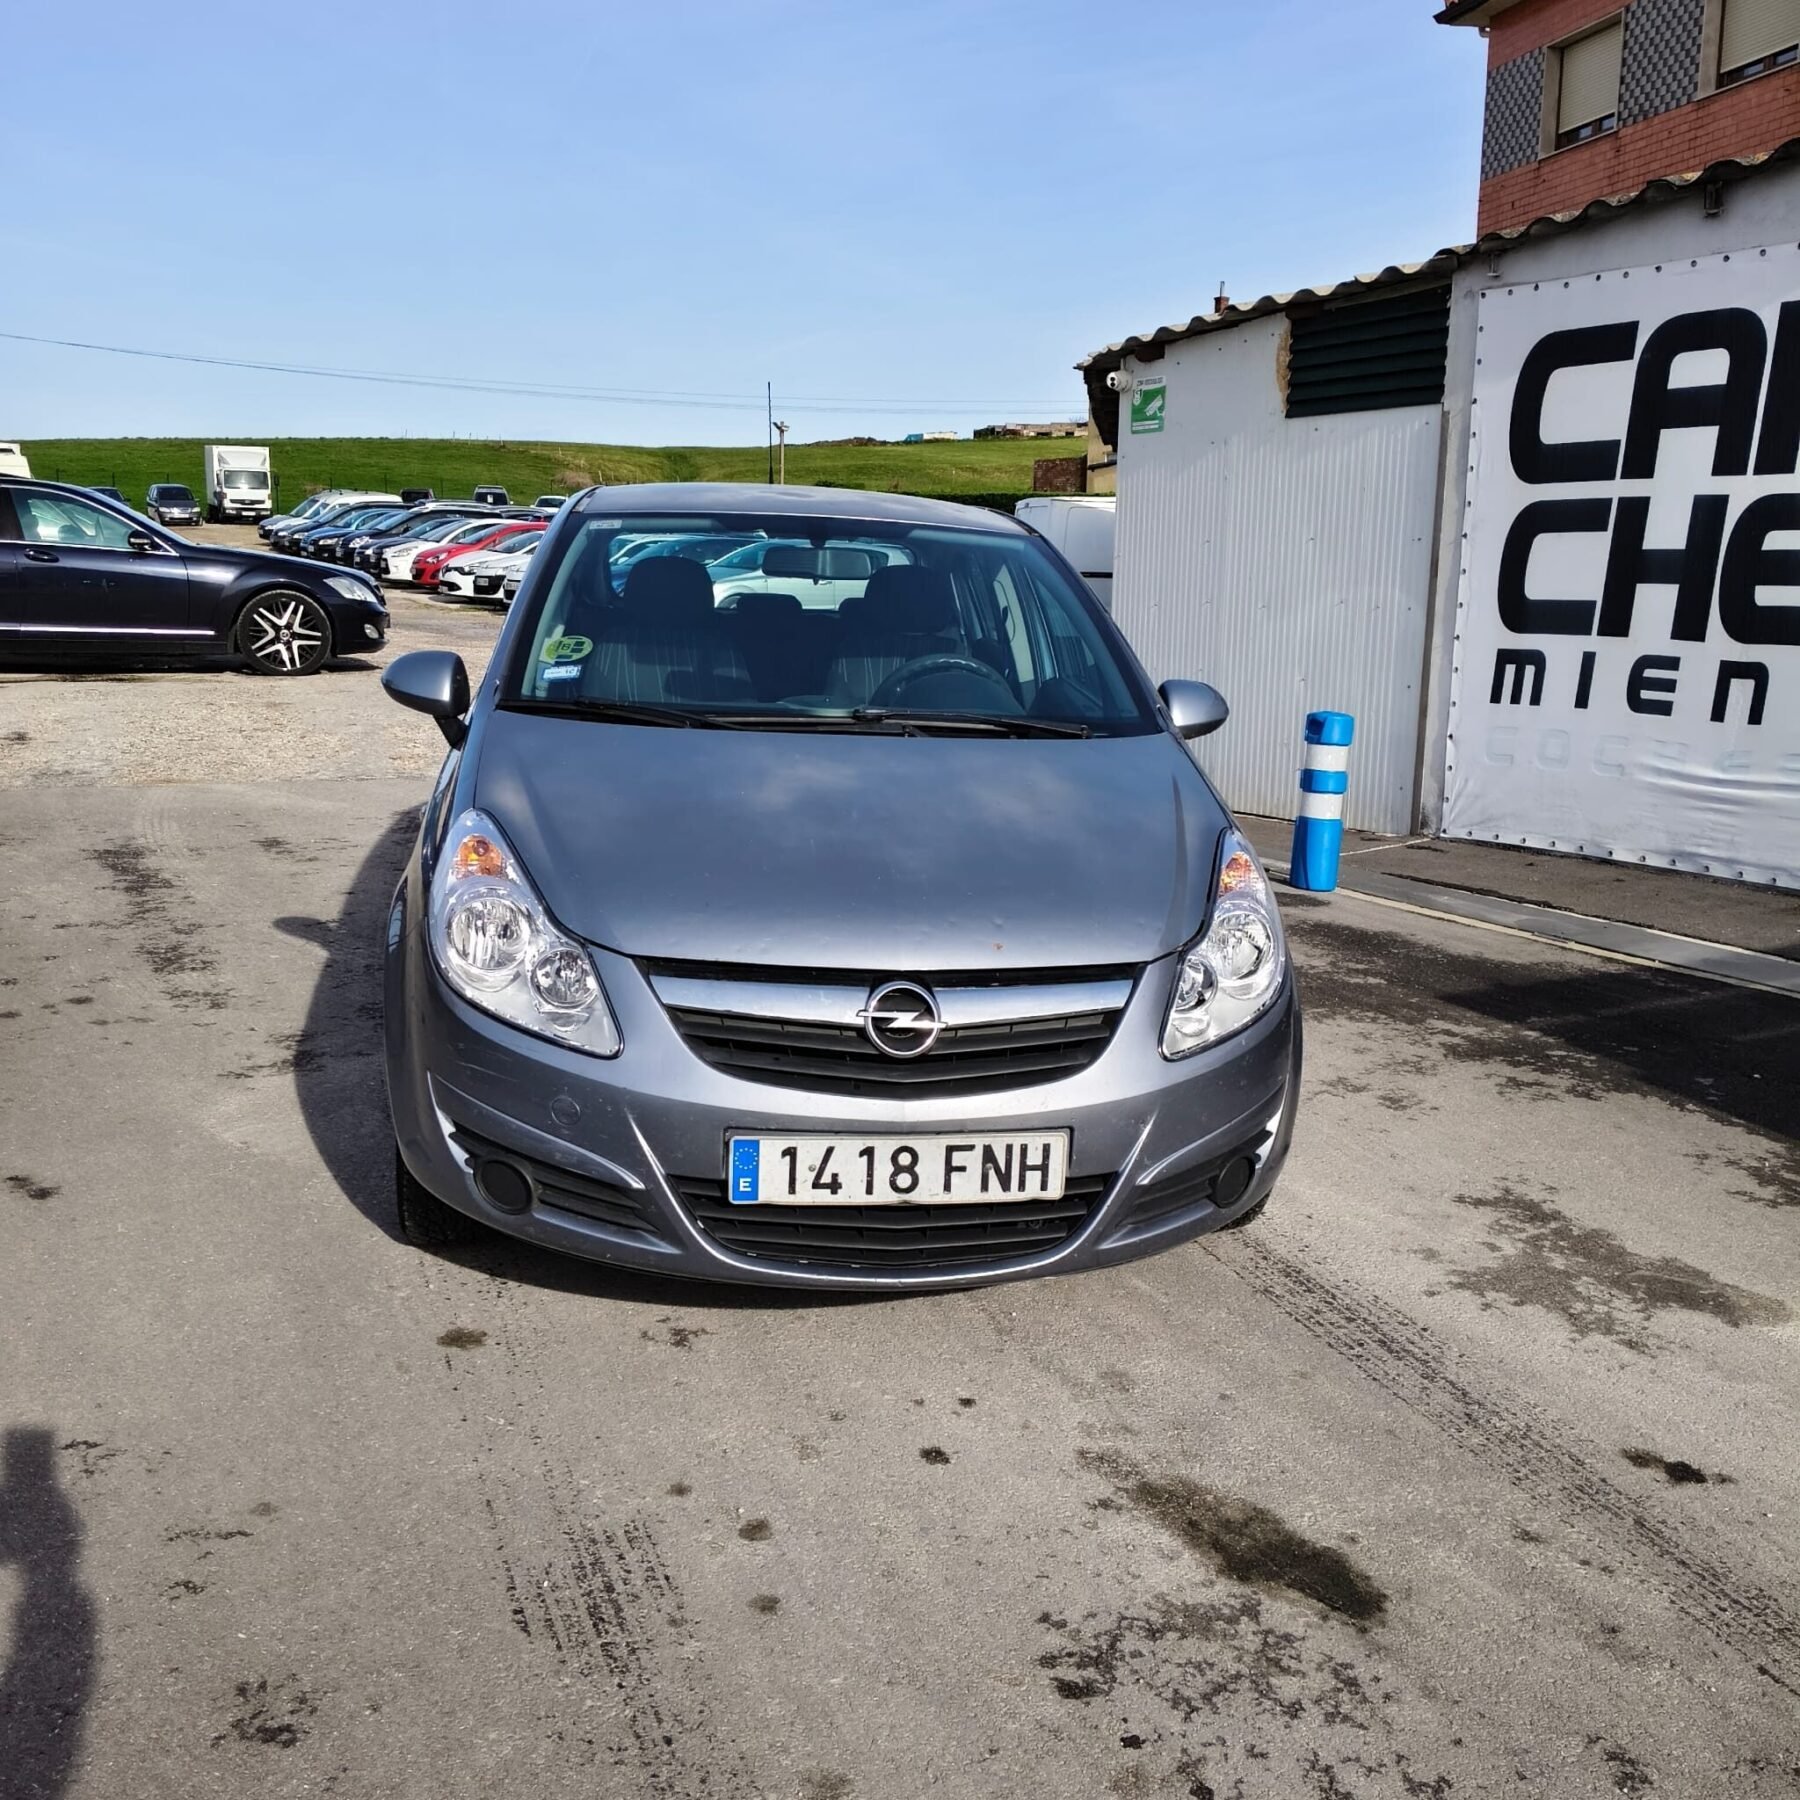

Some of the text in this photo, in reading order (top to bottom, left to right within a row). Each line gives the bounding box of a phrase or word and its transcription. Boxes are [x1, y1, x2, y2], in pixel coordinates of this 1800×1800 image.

[739, 1177, 752, 1192] E
[781, 1143, 1051, 1195] 1418 FNH
